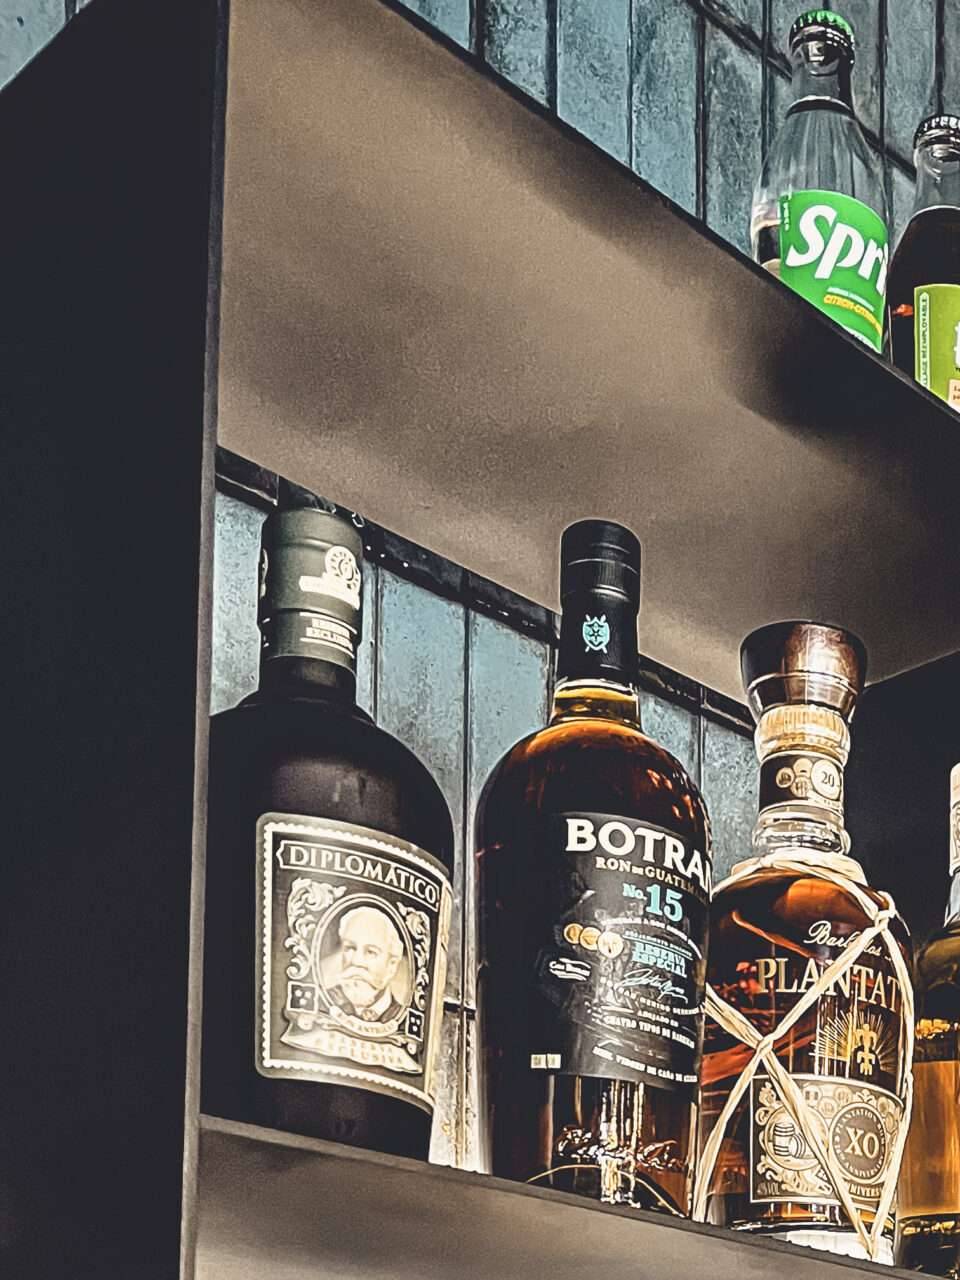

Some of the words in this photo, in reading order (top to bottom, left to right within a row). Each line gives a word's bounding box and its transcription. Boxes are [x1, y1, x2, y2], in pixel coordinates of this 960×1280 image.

[595, 856, 632, 874] RON
[646, 884, 683, 921] 15
[846, 1126, 881, 1160] XO
